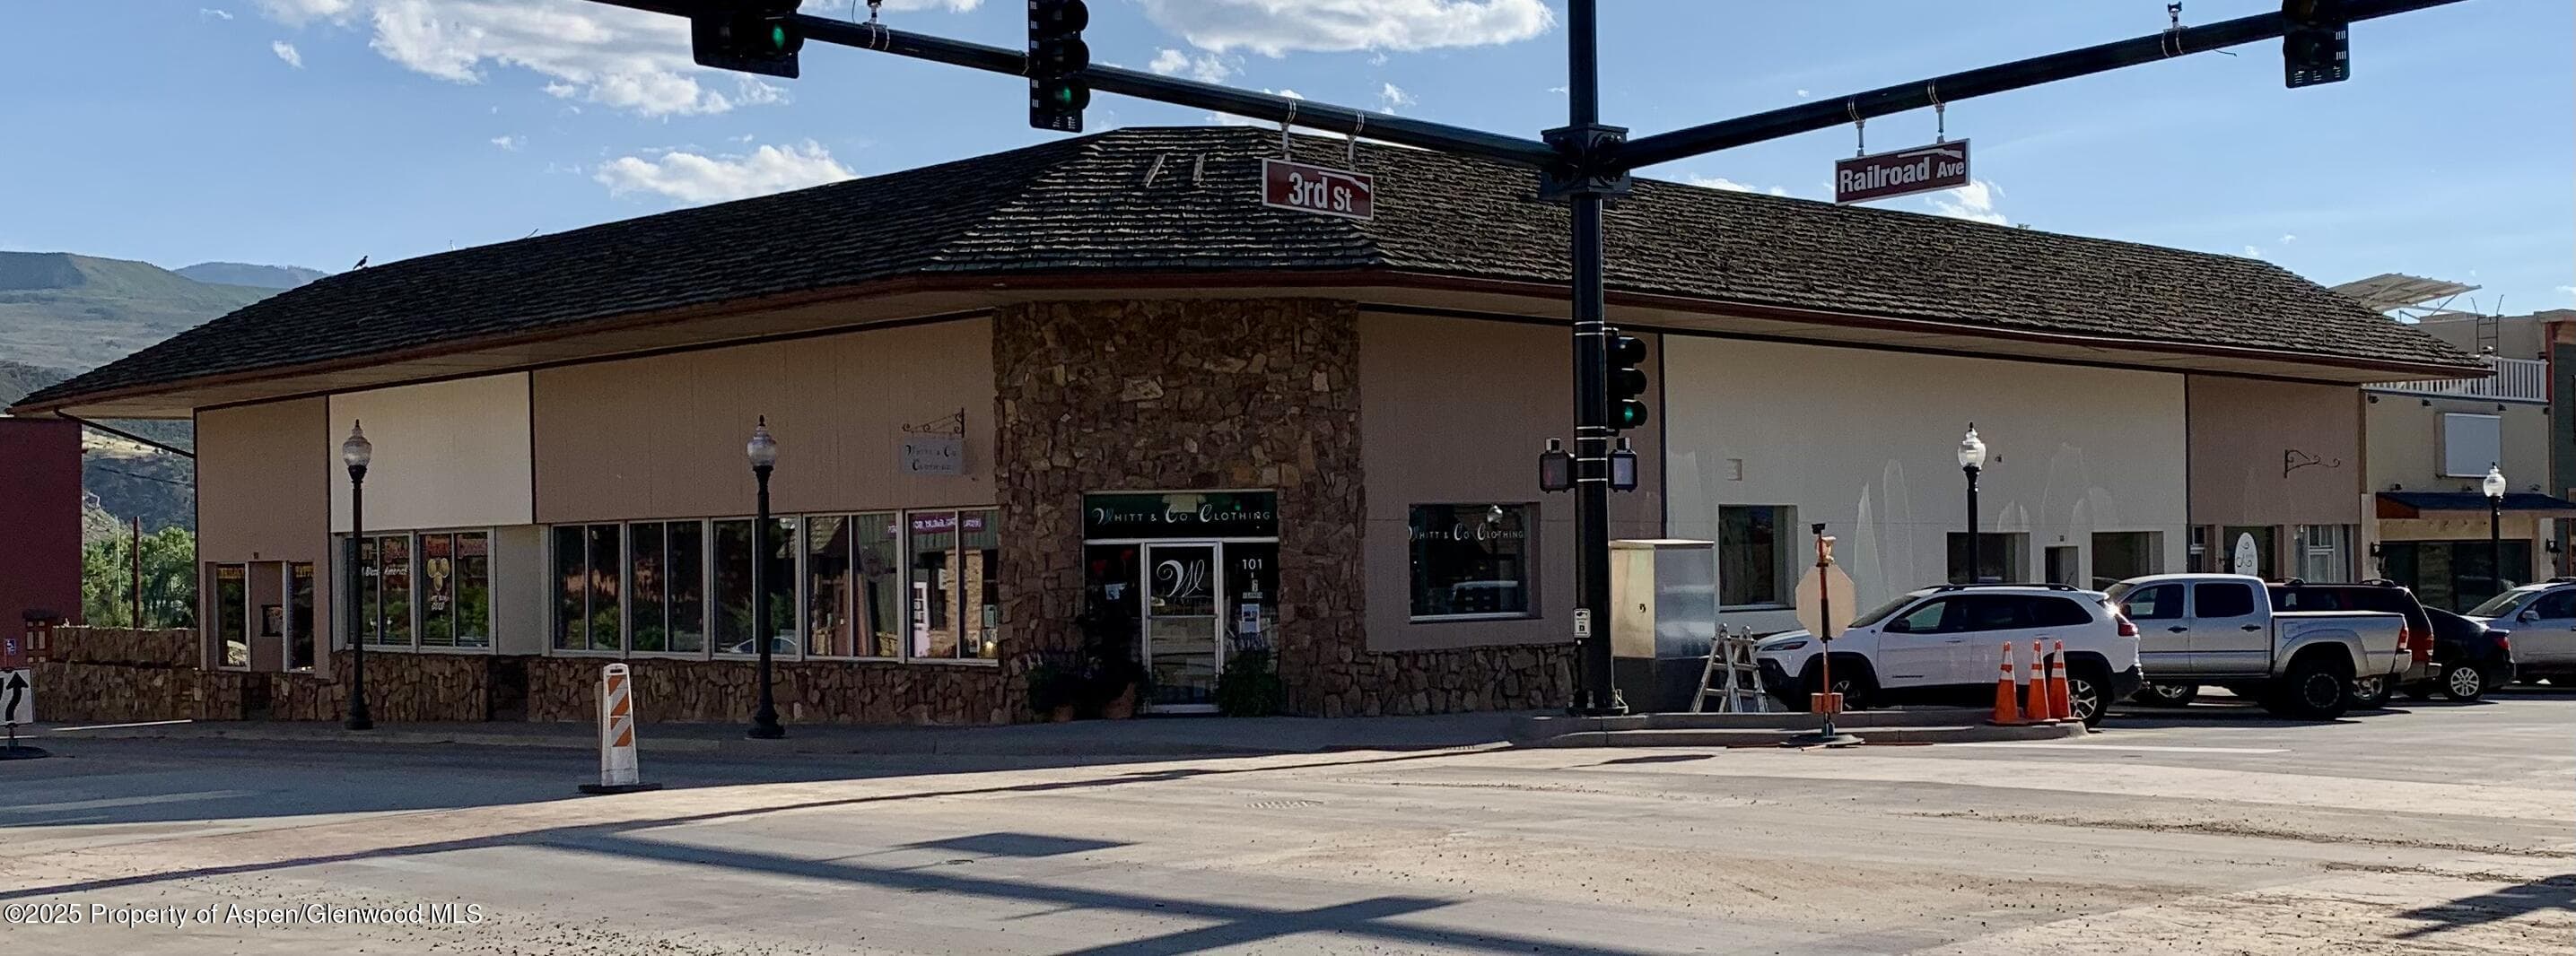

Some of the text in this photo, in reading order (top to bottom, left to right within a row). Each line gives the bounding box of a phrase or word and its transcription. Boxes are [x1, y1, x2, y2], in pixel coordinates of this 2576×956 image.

[1839, 156, 1965, 193] Railroad Ave
[1288, 172, 1352, 212] 3rd St
[1150, 513, 1157, 522] &
[1200, 504, 1271, 523] CLOTHING
[1242, 559, 1262, 569] 101
